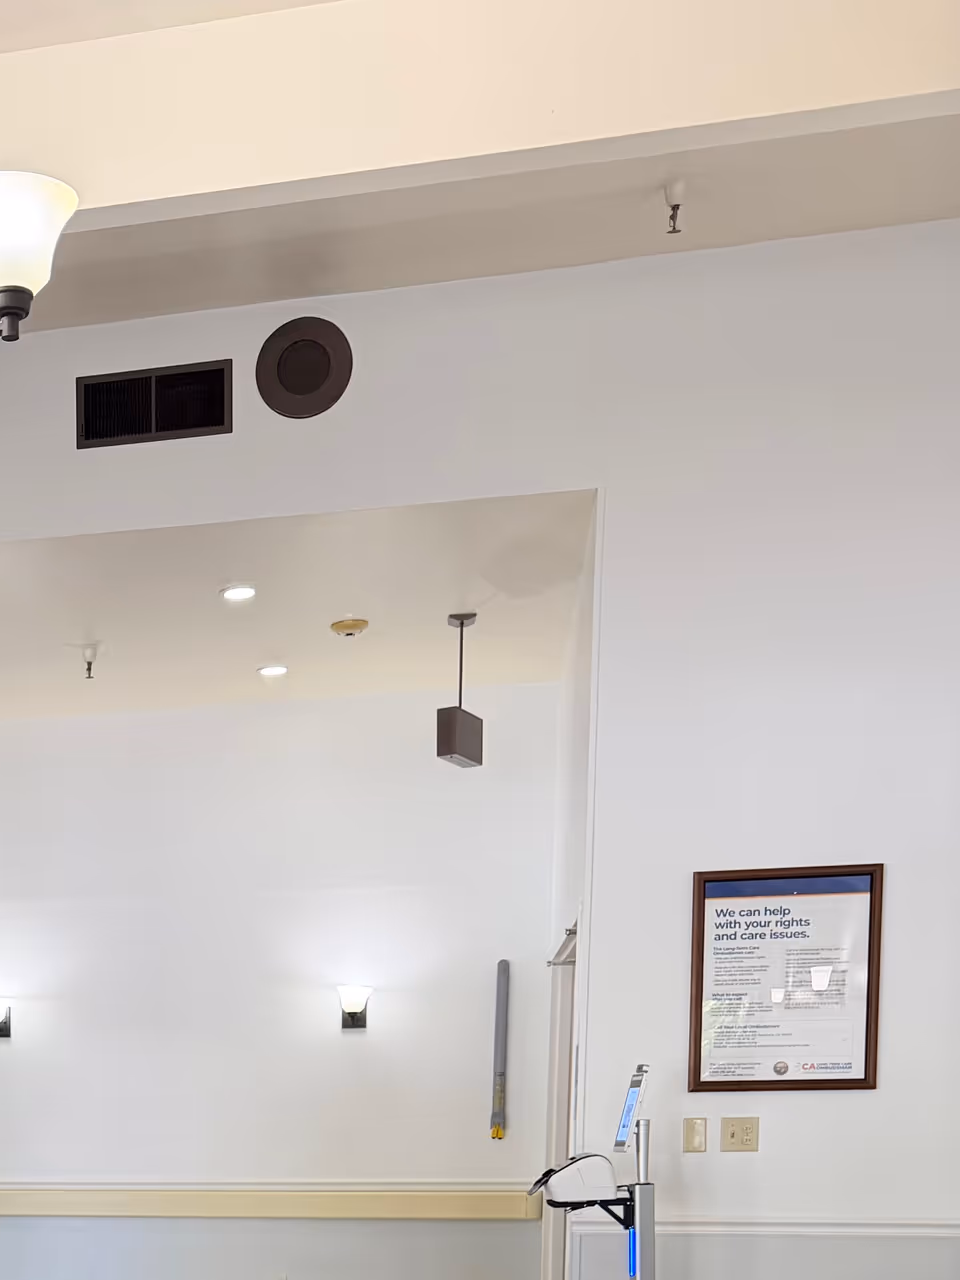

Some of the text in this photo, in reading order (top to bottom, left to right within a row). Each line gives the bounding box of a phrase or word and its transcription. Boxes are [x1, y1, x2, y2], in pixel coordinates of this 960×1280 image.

[715, 905, 791, 918] We can help
[714, 917, 810, 931] with your rights
[713, 929, 810, 941] and care issues.
[801, 1062, 816, 1071] CA
